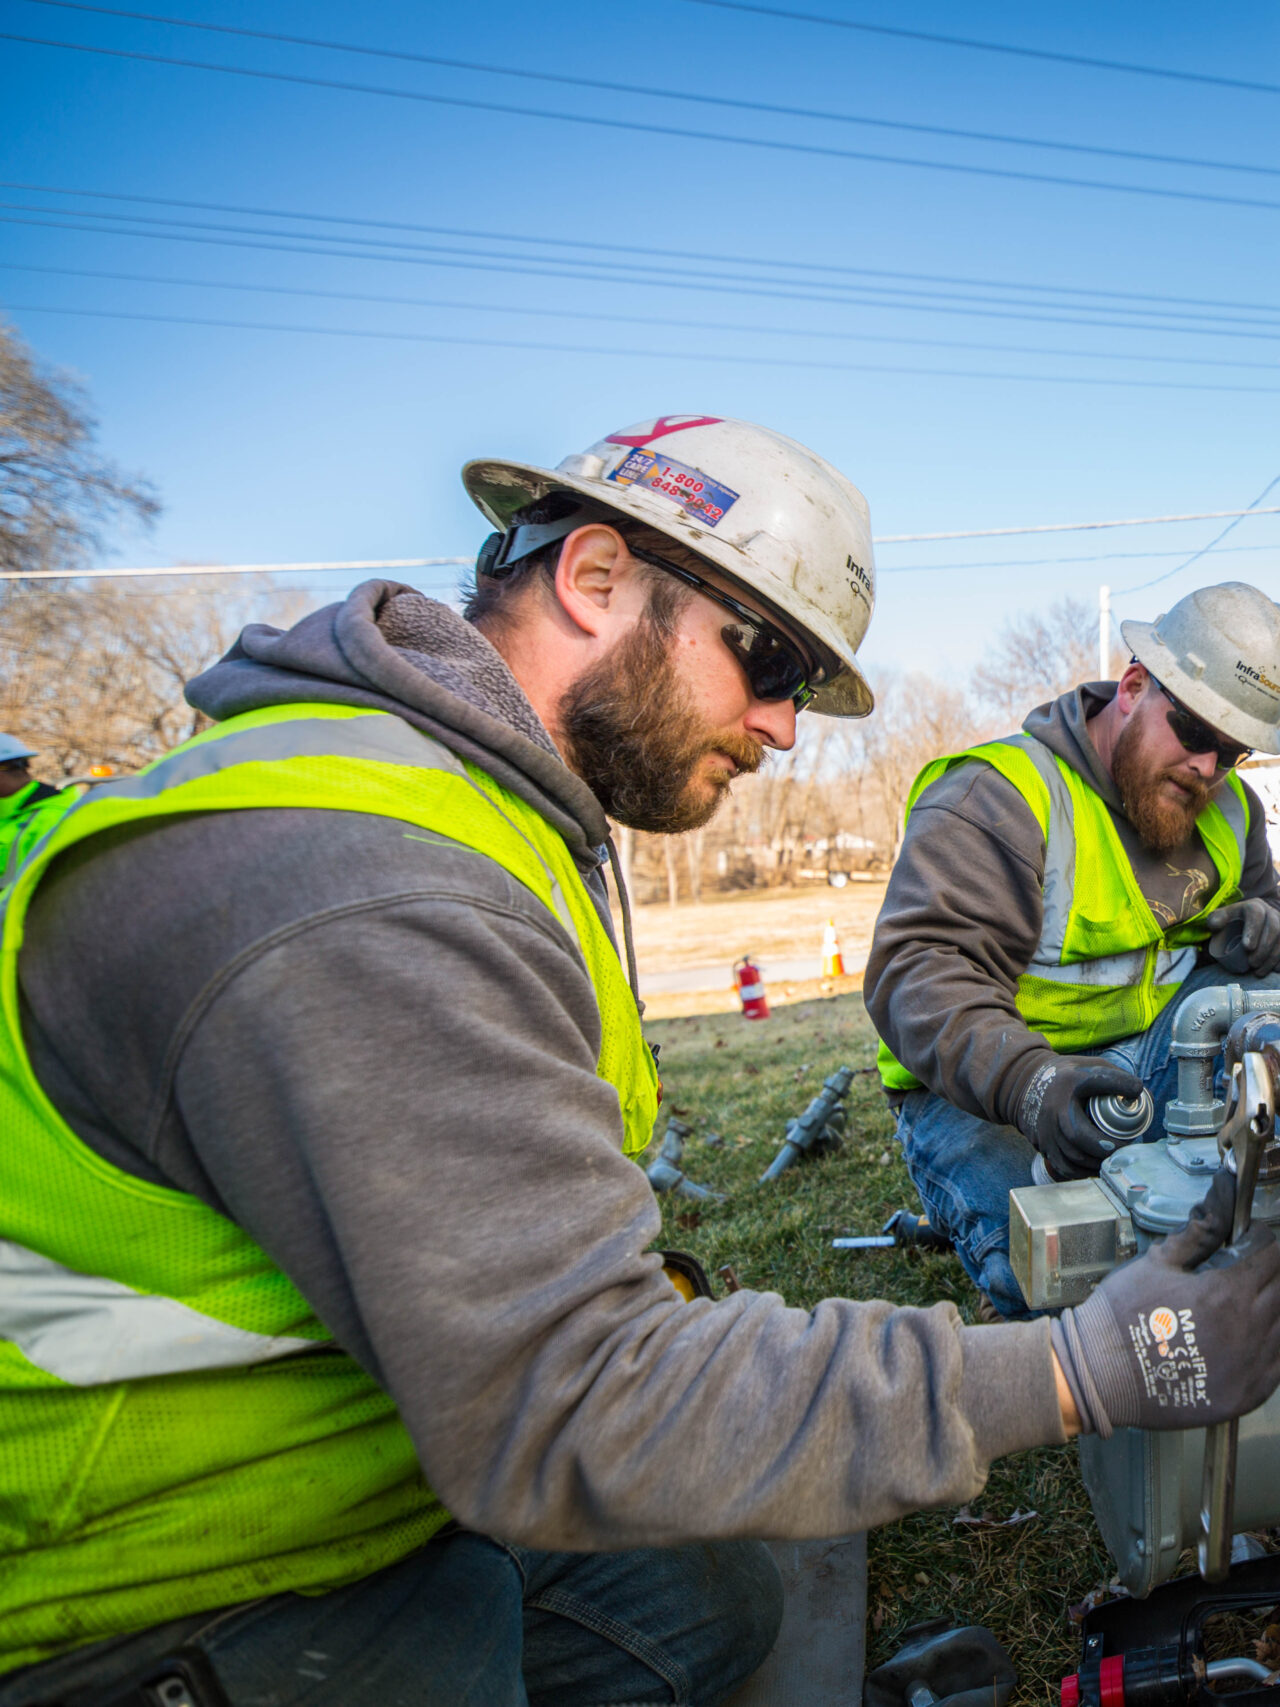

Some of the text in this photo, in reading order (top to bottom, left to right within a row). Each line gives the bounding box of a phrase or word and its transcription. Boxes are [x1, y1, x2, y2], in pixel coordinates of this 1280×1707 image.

[651, 477, 724, 520] 848-9042
[661, 466, 704, 493] 1-800
[846, 554, 871, 592] Infra
[1191, 1008, 1216, 1032] WARD
[1178, 1308, 1208, 1400] MaxiFlex
